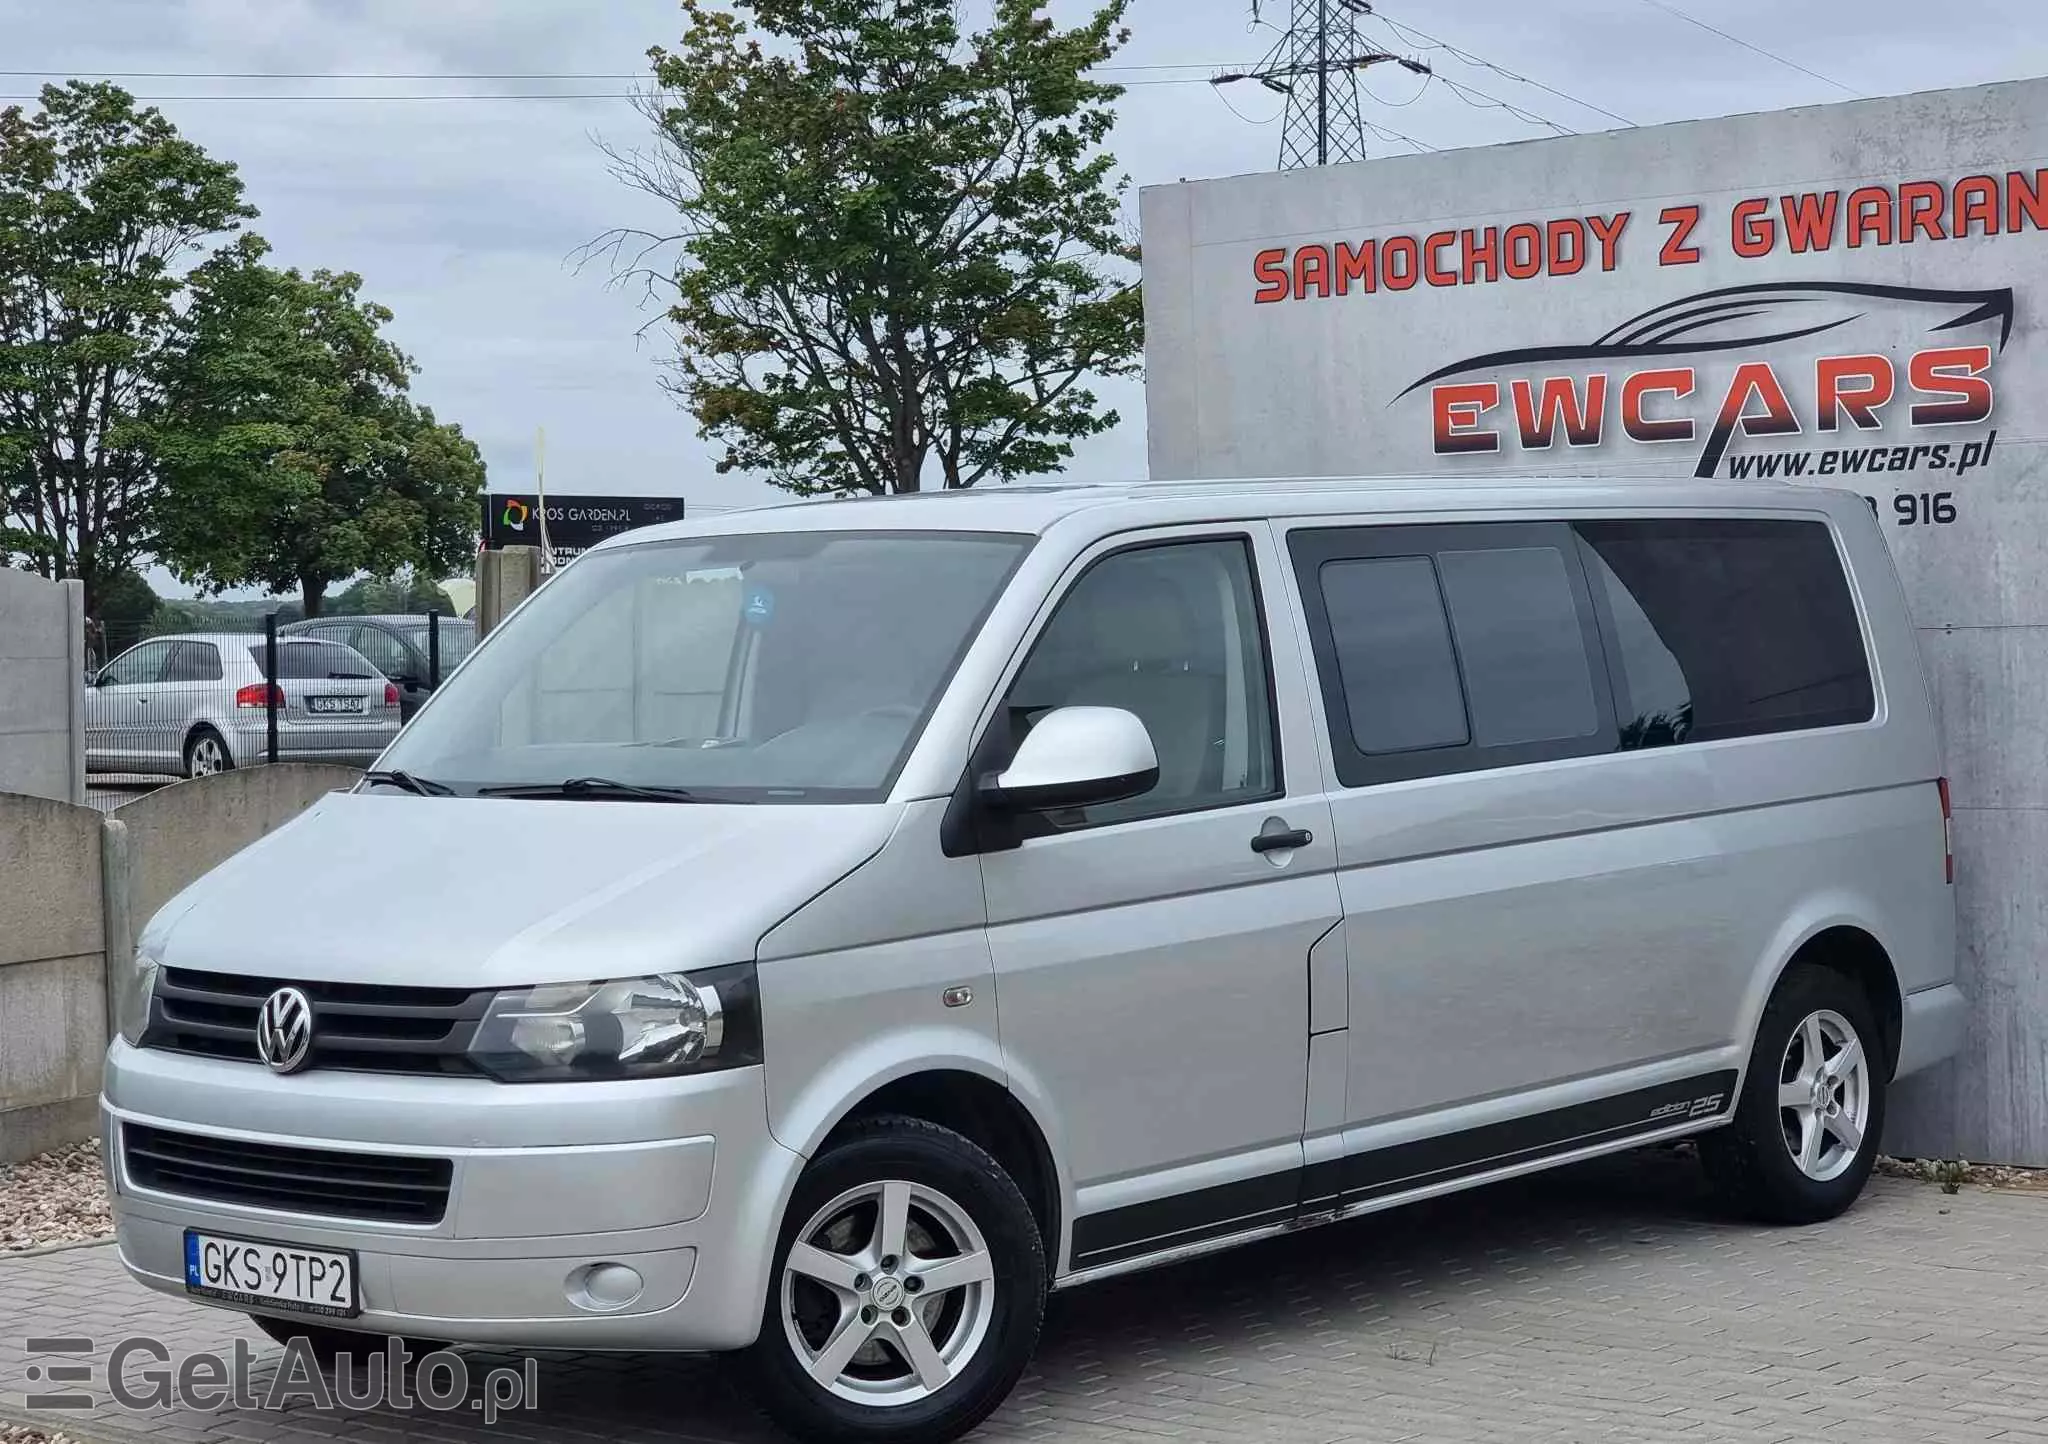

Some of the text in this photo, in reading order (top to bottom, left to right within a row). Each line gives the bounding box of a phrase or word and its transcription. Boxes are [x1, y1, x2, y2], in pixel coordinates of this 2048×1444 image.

[1253, 168, 2048, 305] SAMOCHODY Z GWARAN
[1431, 344, 1995, 479] EWCARS
[1728, 429, 1998, 480] www.ewcars.pl
[568, 507, 631, 521] GARDEN.PL
[1893, 491, 1958, 526] 916
[1688, 1092, 1724, 1118] 25
[189, 1263, 200, 1277] PL
[204, 1241, 347, 1303] GKS 9TP2
